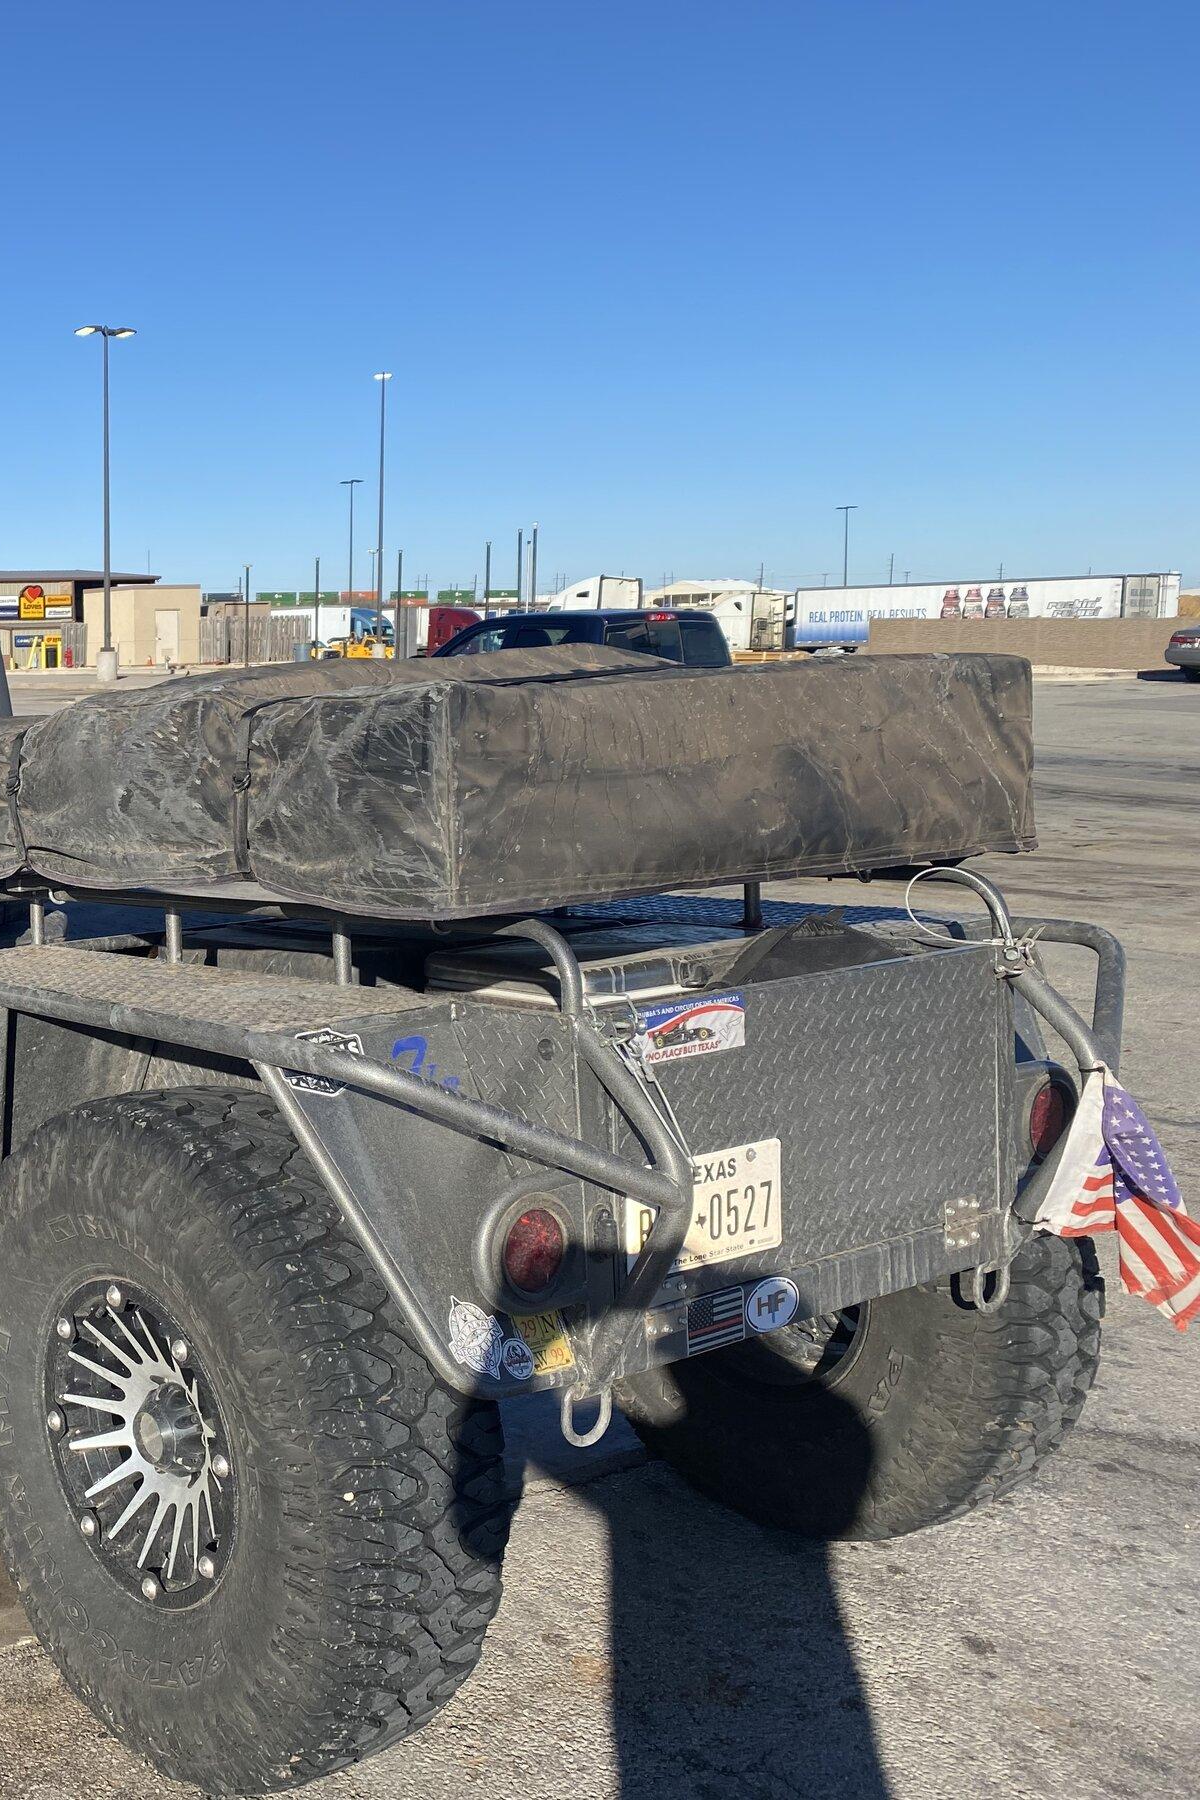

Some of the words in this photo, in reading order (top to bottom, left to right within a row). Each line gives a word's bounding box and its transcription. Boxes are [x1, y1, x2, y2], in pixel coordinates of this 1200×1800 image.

[809, 611, 828, 623] REAL
[661, 1006, 675, 1015] AND
[661, 1046, 682, 1059] PLACE
[683, 1044, 698, 1055] BUT
[692, 1157, 737, 1185] EXAS
[709, 1179, 773, 1241] 0527
[674, 1256, 688, 1266] The
[689, 1252, 707, 1263] Lone
[709, 1247, 724, 1257] Star
[725, 1243, 744, 1254] State
[521, 1319, 537, 1339] 29
[550, 1347, 564, 1362] 99
